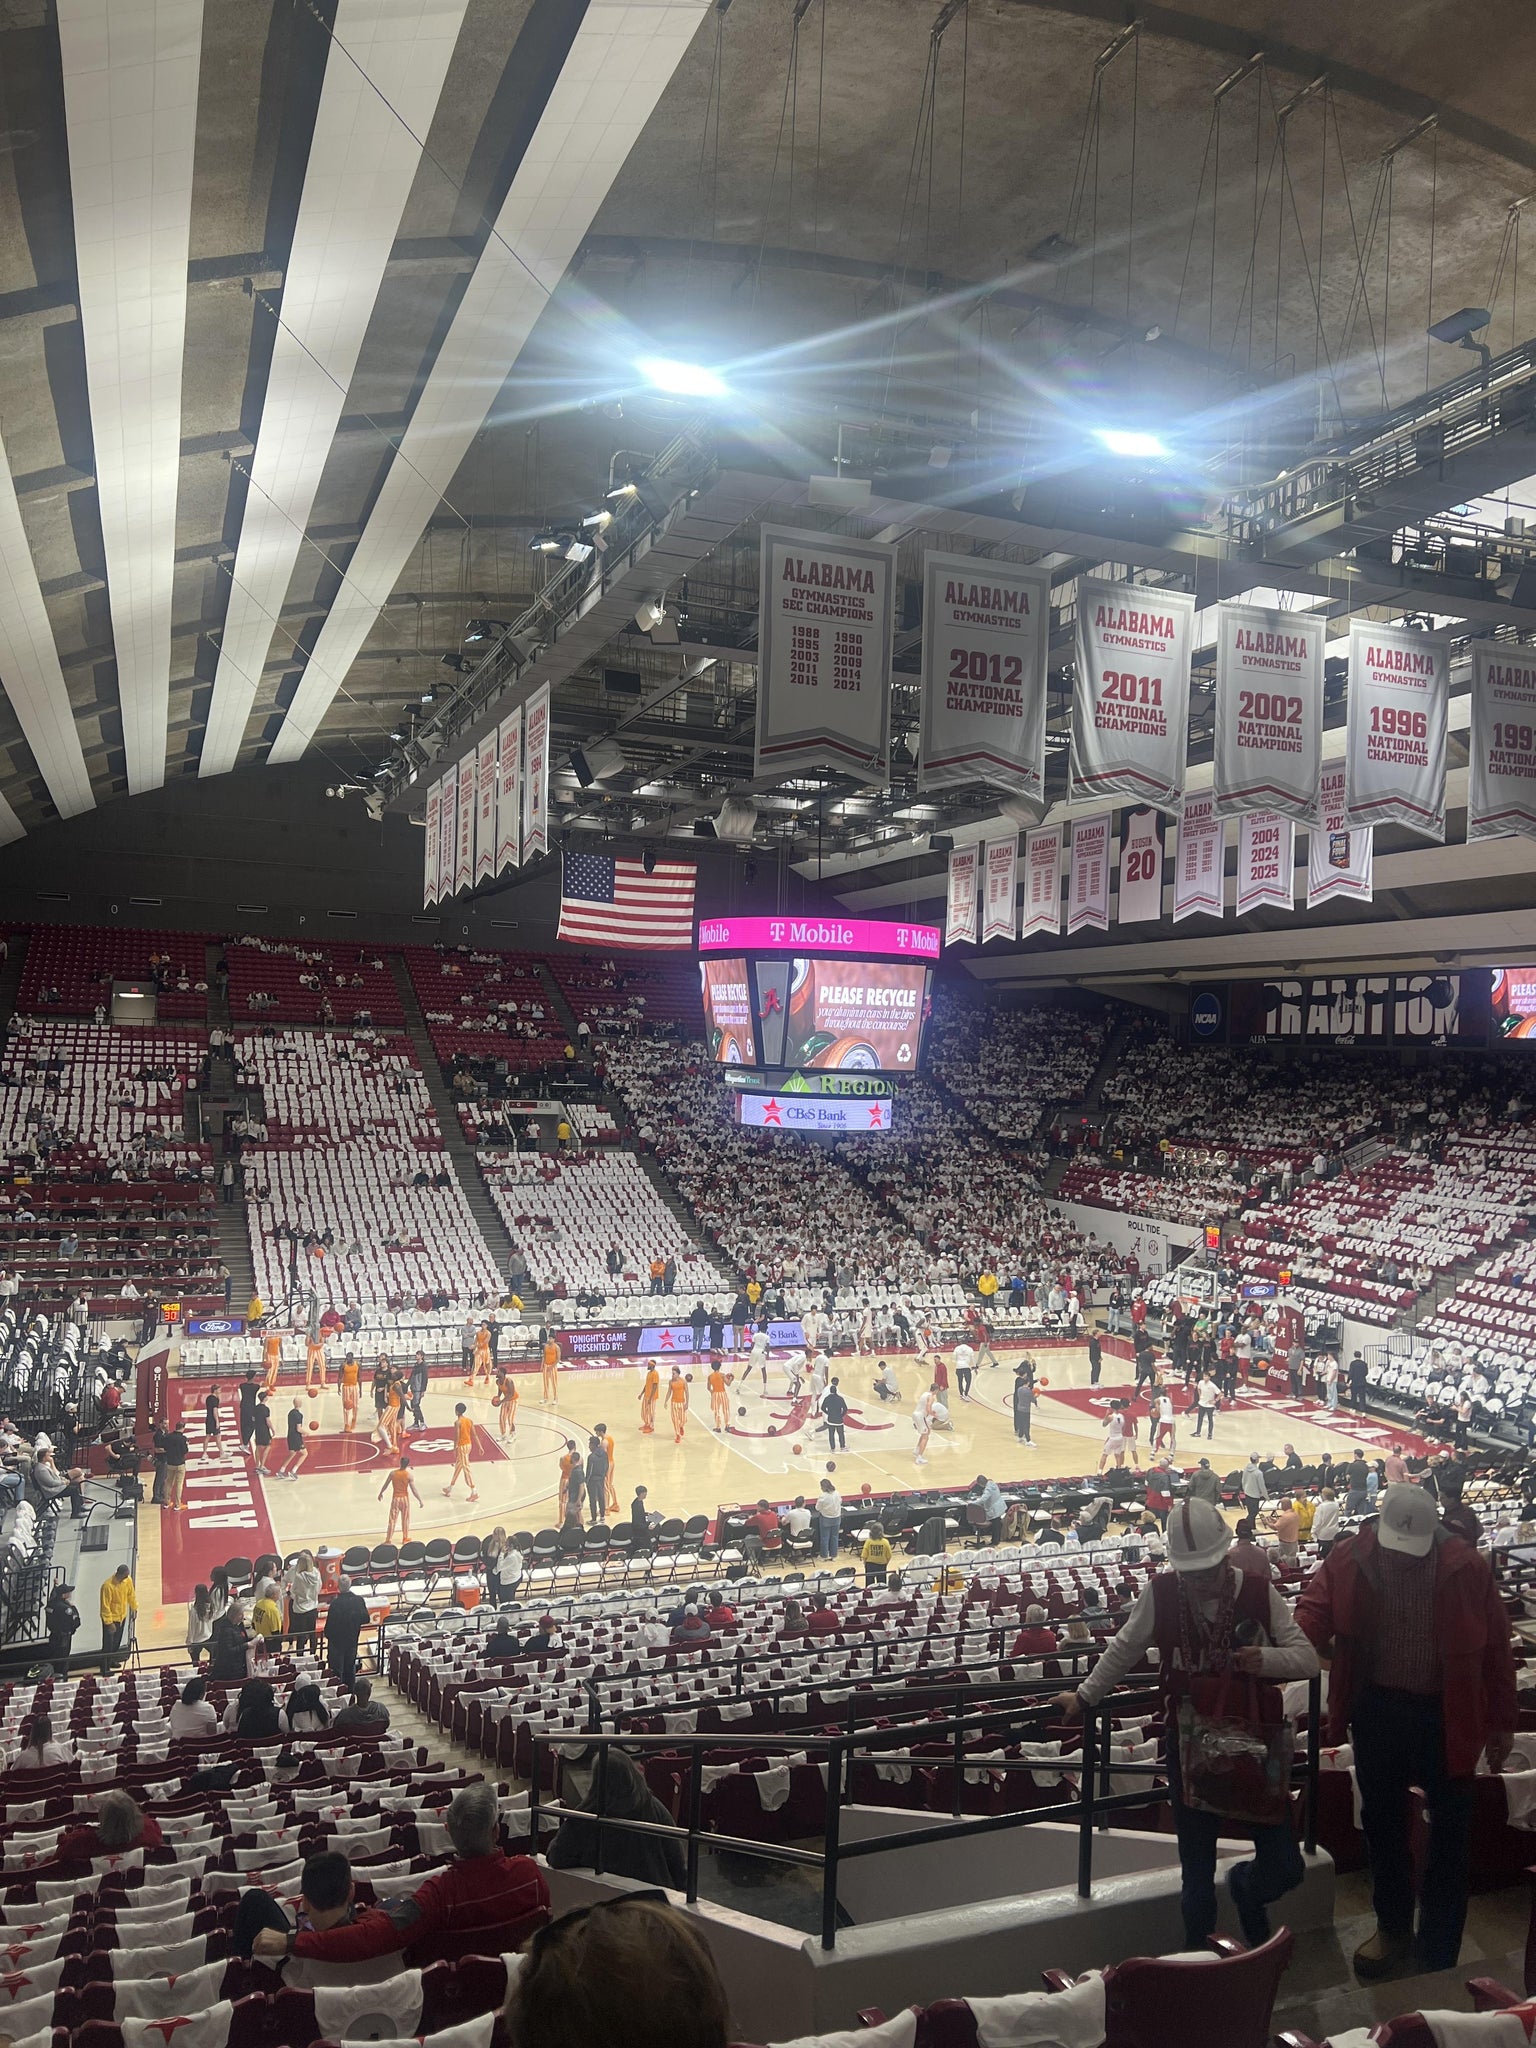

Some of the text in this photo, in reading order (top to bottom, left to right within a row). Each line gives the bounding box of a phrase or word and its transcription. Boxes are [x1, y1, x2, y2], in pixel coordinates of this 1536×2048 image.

[782, 557, 875, 594] ALABAMA
[792, 588, 865, 608] GYMNASTICS
[944, 580, 1030, 615] ALABAMA
[782, 599, 873, 622] SEC CHAMPIONS
[953, 610, 1021, 629] GYMNASTICS
[1095, 605, 1175, 639] ALABAMA
[792, 626, 862, 645] 1988 1990
[1102, 632, 1166, 652] GYMNASTICS
[1235, 628, 1308, 659] ALABAMA
[792, 638, 862, 656] 1995 2000
[790, 650, 862, 668] 2003 2009
[949, 648, 1022, 686] 2012
[1242, 655, 1302, 672] GYMNASTICS
[1366, 646, 1434, 676] ALABAMA
[790, 662, 862, 680] 2011 2014
[1372, 671, 1427, 688] GYMNASTICS
[790, 674, 861, 692] 2015 2021
[1102, 670, 1162, 706] 2011
[946, 681, 1023, 704] NATIONAL
[946, 698, 1023, 718] CHAMPIONS
[1096, 700, 1166, 724] NATIONAL
[1238, 690, 1302, 724] 2002
[1094, 716, 1166, 737] CHAMPIONS
[1238, 720, 1302, 741] NATIONAL
[1370, 706, 1427, 738] 1996
[1238, 735, 1302, 753] CHAMPIONS
[1368, 734, 1428, 754] NATIONAL
[1367, 748, 1428, 767] CHAMPIONS
[1076, 826, 1104, 842] ALABAMA
[1252, 828, 1280, 846] 2004
[1032, 837, 1056, 852] ALABAMA
[1251, 846, 1279, 863] 2024
[1126, 848, 1156, 882] 20
[1250, 864, 1278, 880] 2025
[770, 922, 854, 944] T Mobile
[896, 928, 938, 951] T Mobile
[820, 986, 916, 1007] PLEASE RECYCLE
[816, 1007, 833, 1018] your
[833, 1006, 866, 1018] aluminum
[883, 1009, 890, 1019] in
[890, 1008, 900, 1020] the
[900, 1008, 916, 1020] bins
[1194, 1013, 1217, 1024] NCAA
[824, 1016, 909, 1030] throughout the concourse!
[1249, 1035, 1267, 1044] ALFA
[786, 1108, 847, 1121] CB&S Bank
[1128, 1220, 1160, 1234] ROLL TIDE
[164, 1311, 177, 1320] 30
[204, 1321, 226, 1332] Ford
[778, 1328, 798, 1338] Bank
[568, 1332, 626, 1344] TONIGHT'S GAME
[574, 1342, 622, 1352] PRESENTED BY:
[1274, 1348, 1288, 1358] YETI
[1268, 1366, 1290, 1381] Coca-Cola
